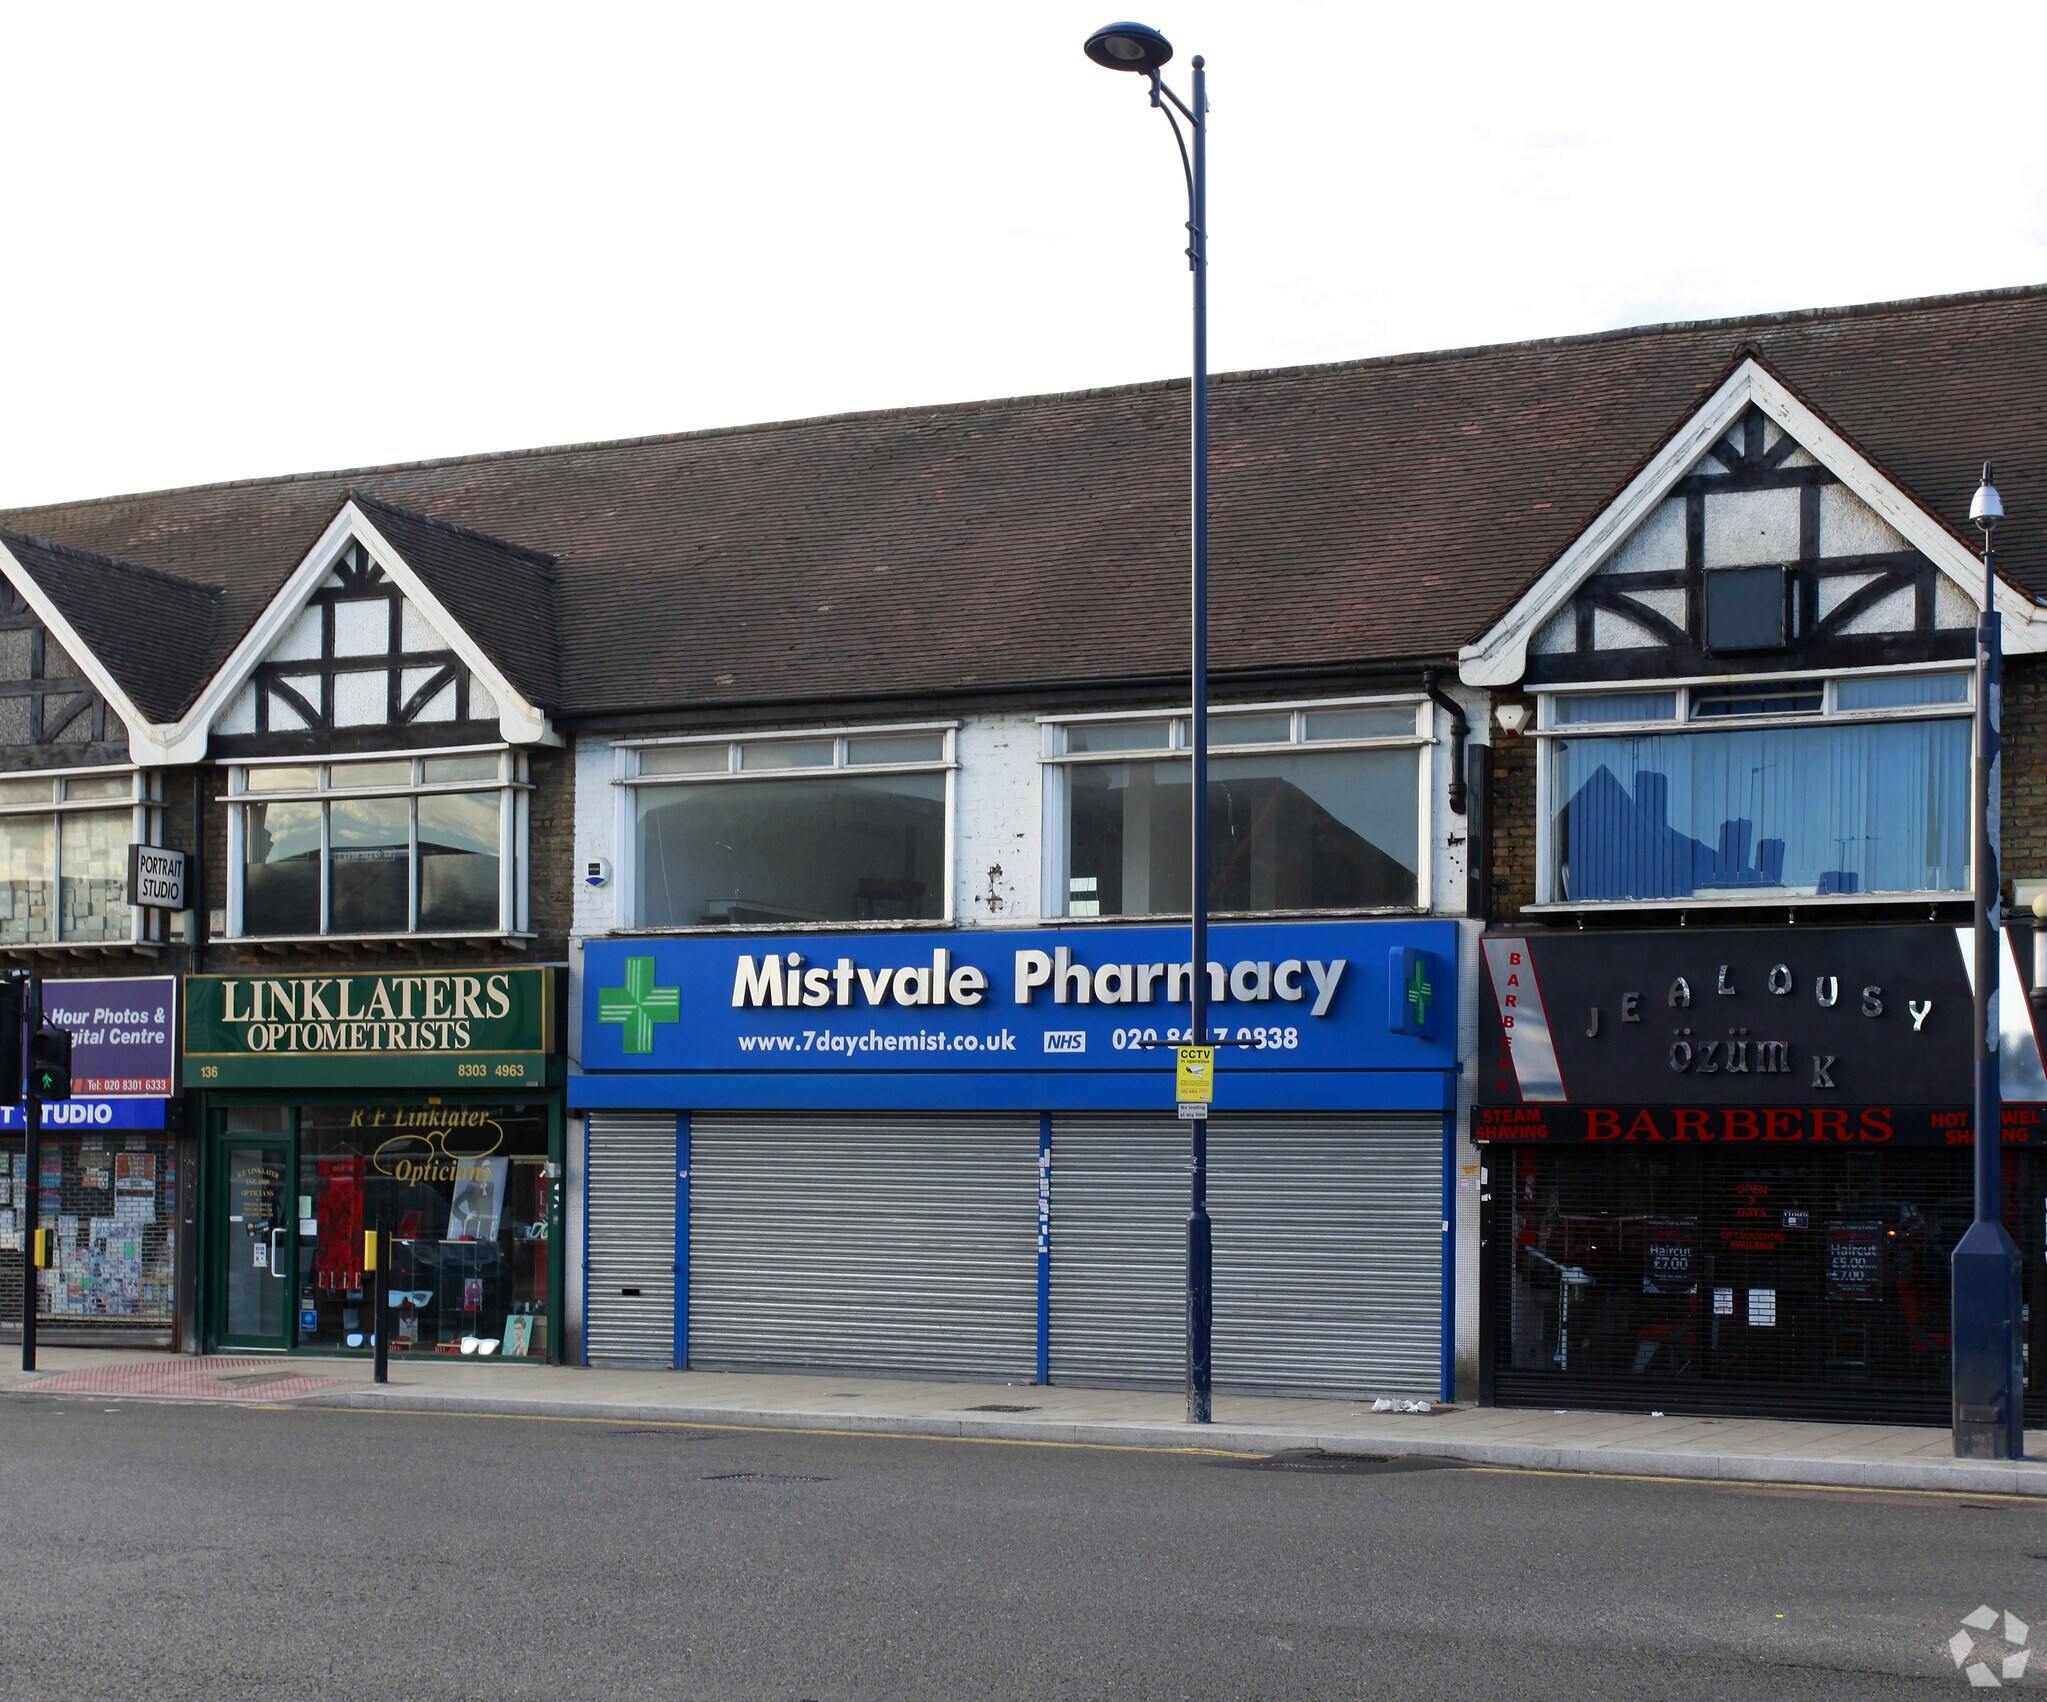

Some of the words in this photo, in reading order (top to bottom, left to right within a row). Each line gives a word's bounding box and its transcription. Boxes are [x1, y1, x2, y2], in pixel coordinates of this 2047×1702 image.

[140, 854, 183, 878] PORTRAIT
[142, 878, 180, 901] STUDIO
[732, 948, 988, 1007] Mistvale
[1015, 946, 1349, 1016] Pharmacy
[221, 974, 511, 1023] LINKLATERS
[52, 1008, 90, 1025] Hour
[93, 1008, 150, 1025] Photos
[154, 1007, 166, 1024] &
[109, 1027, 166, 1045] Centre
[246, 1020, 471, 1051] OPTOMETRISTS
[738, 1029, 1017, 1056] www.7daychemist.co.uk
[1046, 1034, 1085, 1050] NHS
[1112, 1028, 1157, 1050] 020
[1236, 1026, 1299, 1050] 0838
[1180, 1049, 1211, 1059] CCTV
[200, 1065, 218, 1078] 136
[458, 1064, 487, 1077] 8303
[495, 1063, 524, 1077] 4963
[87, 1079, 102, 1091] Tel:
[104, 1079, 120, 1091] 020
[122, 1079, 142, 1091] 8301
[145, 1079, 166, 1091] 6333
[22, 1103, 113, 1125] TUDIO
[349, 1108, 365, 1128] R
[394, 1107, 491, 1128] Linklater
[1482, 1108, 1541, 1125] STEAM
[1930, 1111, 1969, 1128] HOT
[1475, 1123, 1549, 1141] SHAVING
[1583, 1107, 1894, 1142] BARBERS
[247, 1167, 280, 1180] LINKLATER
[395, 1158, 492, 1187] Opticians
[240, 1189, 275, 1198] OPTICIANS
[1735, 1184, 1770, 1196] OPEN
[1736, 1207, 1768, 1217] DAYS
[1650, 1245, 1693, 1258] Haircut
[1830, 1244, 1878, 1257] Haircut
[317, 1271, 363, 1290] ELLE
